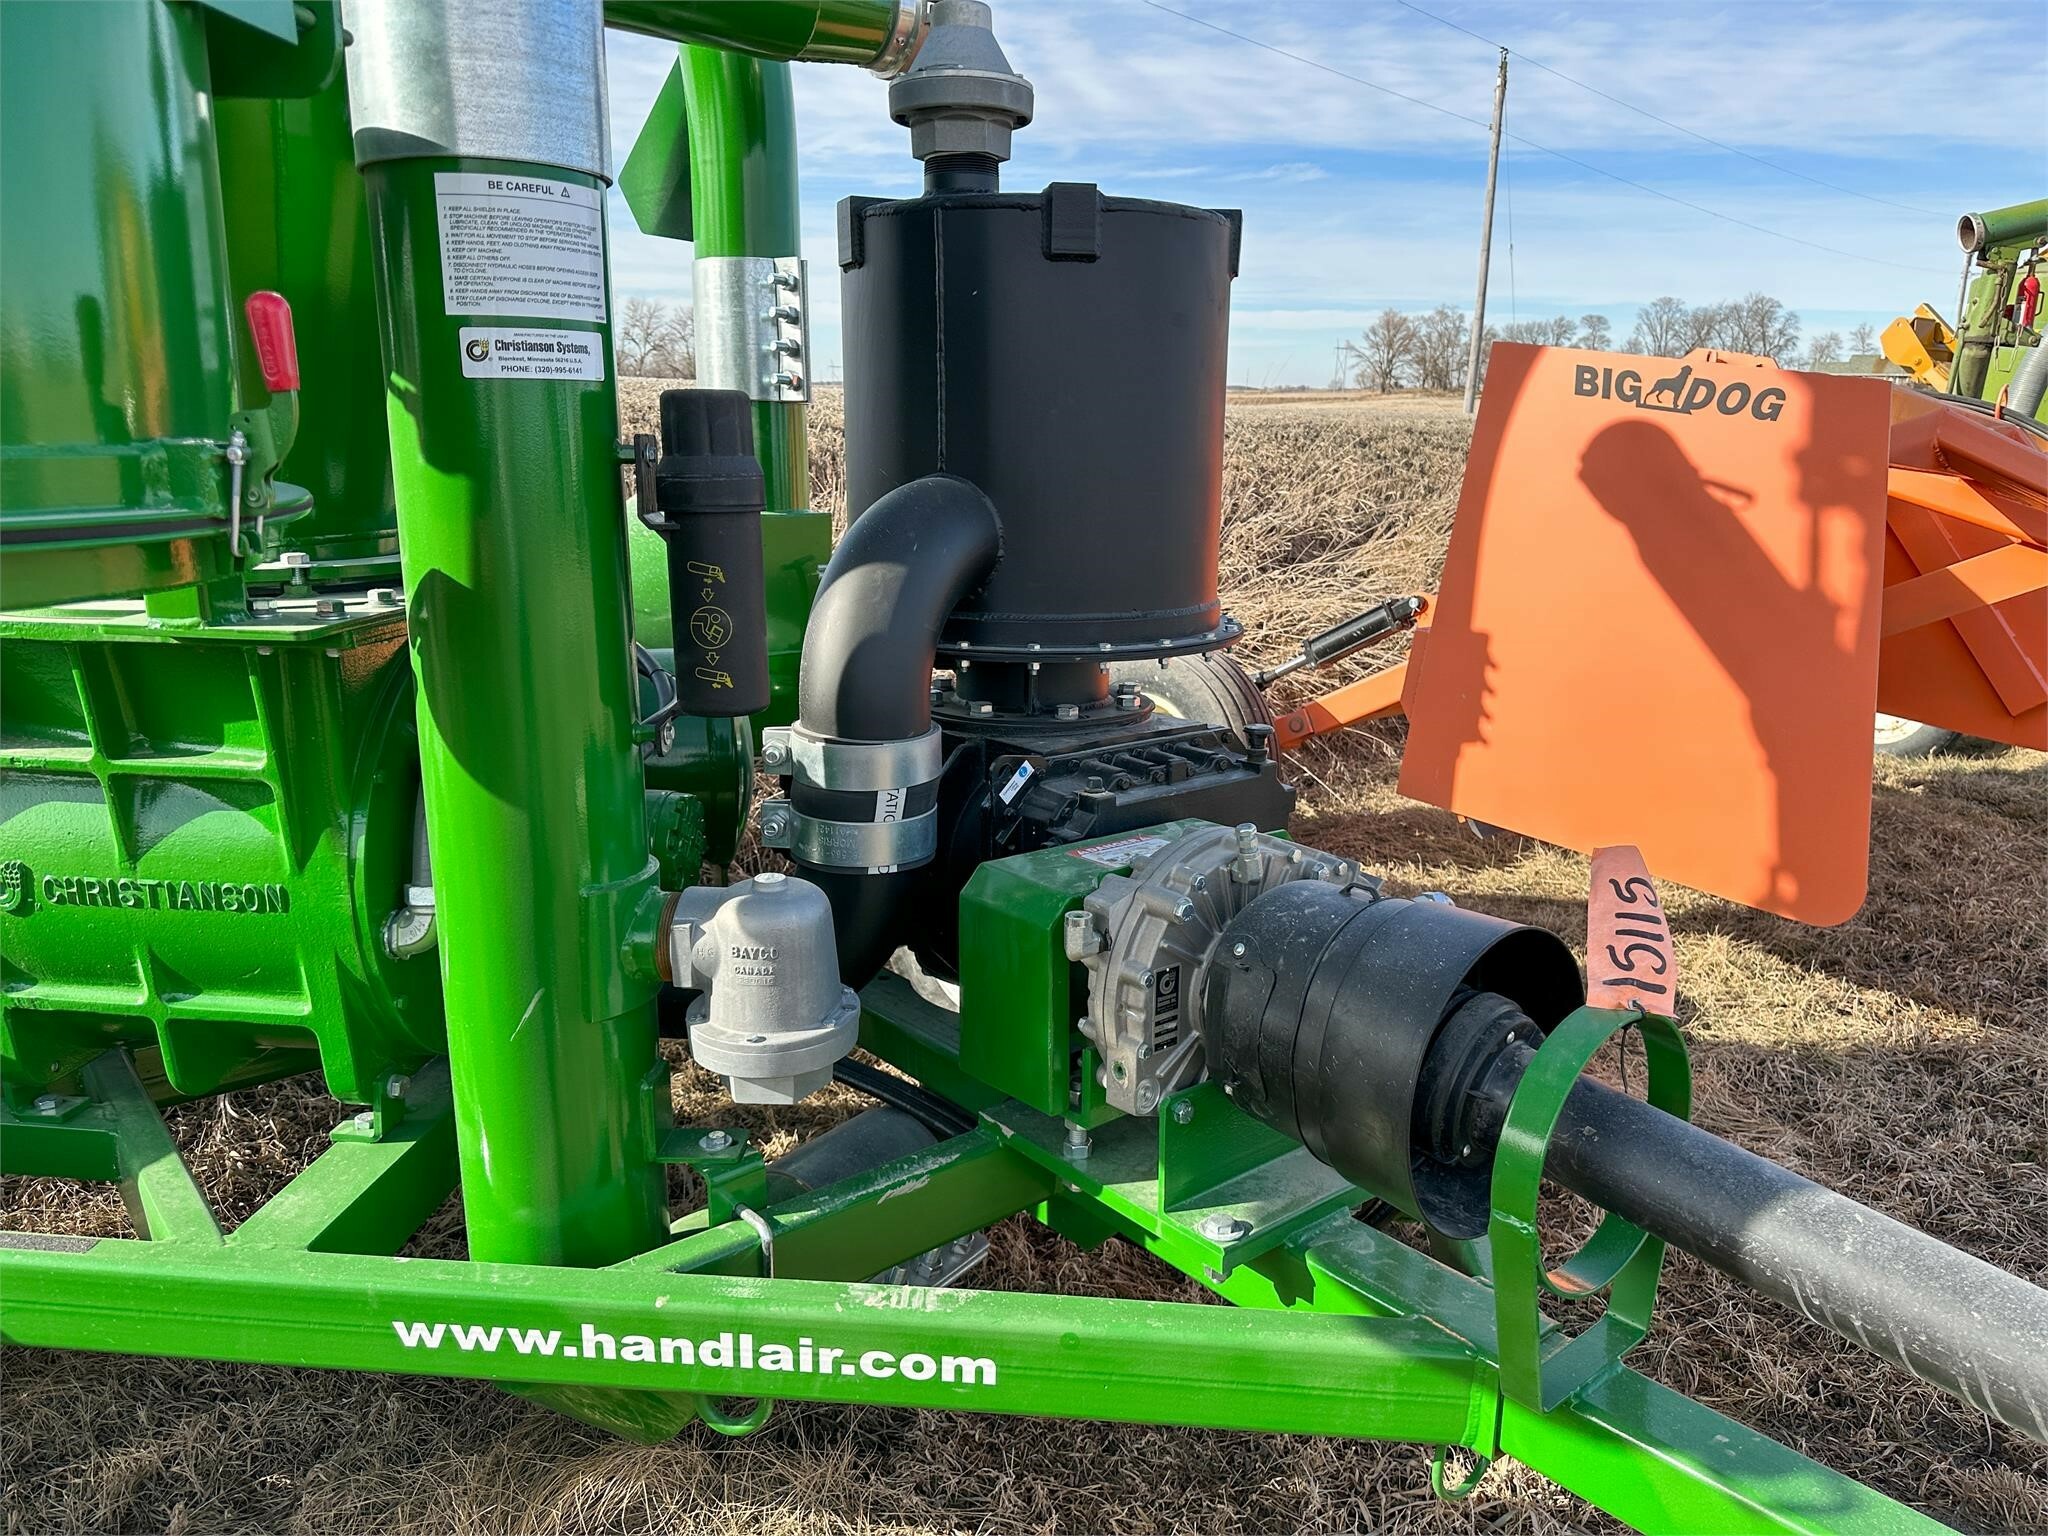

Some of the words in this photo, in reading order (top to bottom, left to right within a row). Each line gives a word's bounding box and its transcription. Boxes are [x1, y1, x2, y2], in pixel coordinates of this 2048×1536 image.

[488, 180, 503, 190] BE
[506, 181, 554, 195] CAREFUL
[495, 339, 554, 352] Christianson
[556, 341, 590, 356] Systems,
[534, 366, 582, 374] (320)-995-6141
[1574, 364, 1642, 404] BIG
[1680, 377, 1786, 422] DOG
[43, 874, 291, 914] CHRISTIANSON
[1602, 877, 1667, 995] 15115
[731, 946, 779, 960] BAYCO
[734, 965, 774, 976] CANADA
[391, 1319, 998, 1386] www.handlair.com
